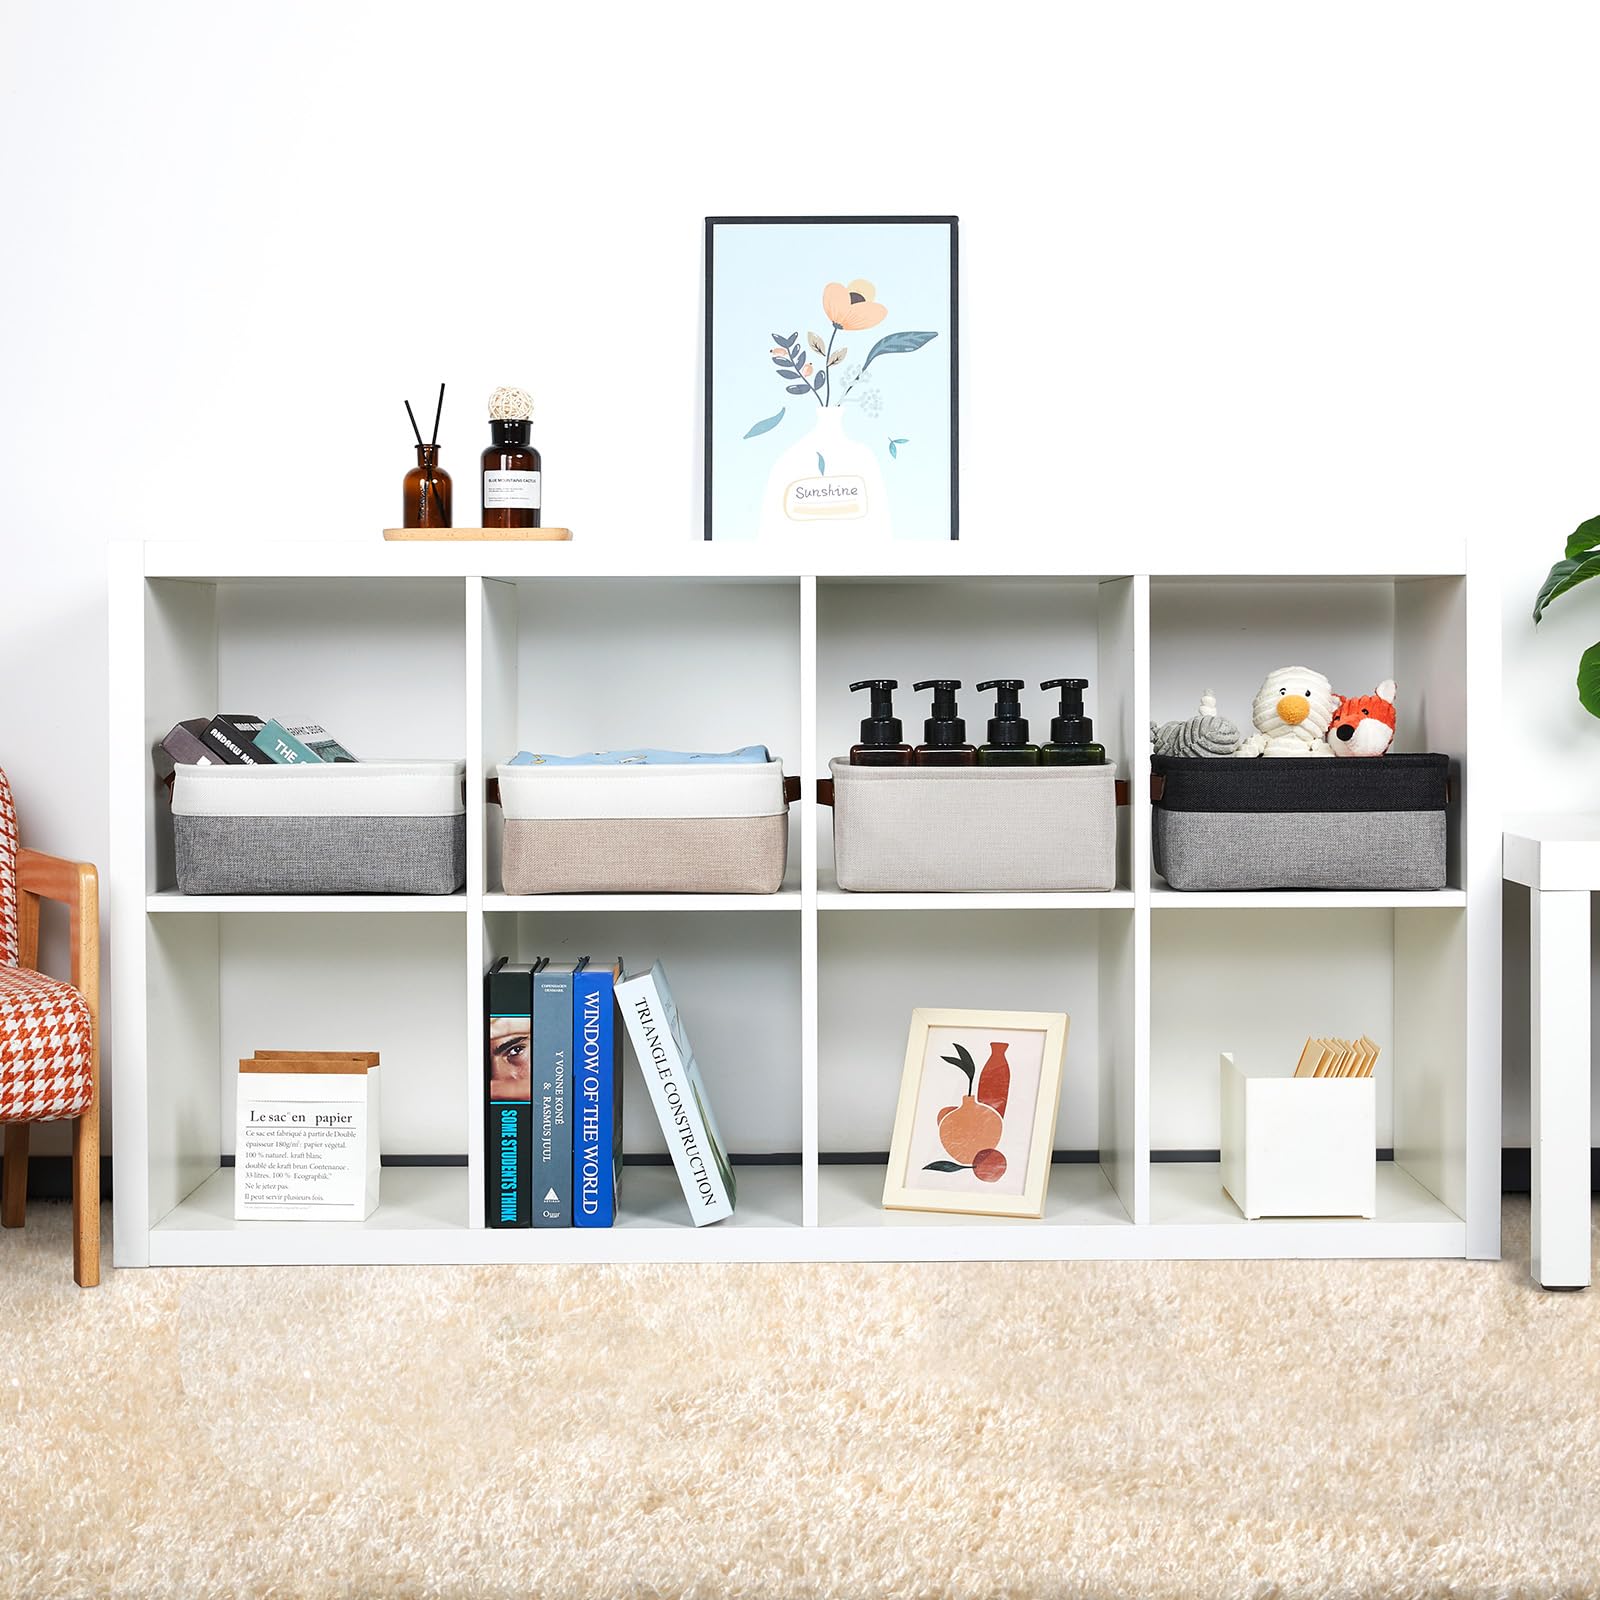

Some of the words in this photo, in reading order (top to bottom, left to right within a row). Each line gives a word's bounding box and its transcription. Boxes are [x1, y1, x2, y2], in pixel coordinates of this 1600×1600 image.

[796, 484, 858, 499] Sunshine
[210, 728, 242, 756] ANDREW
[240, 753, 258, 765] MA
[275, 739, 298, 764] THE
[584, 990, 600, 1074] WINDOW
[583, 1076, 600, 1102] OF
[635, 997, 672, 1080] TRIANGLE
[664, 1082, 716, 1206] CONSTRUCTION
[250, 1110, 266, 1122] Le
[292, 1114, 306, 1122] en
[316, 1112, 352, 1126] papier
[501, 1110, 518, 1138] SOME
[543, 1096, 552, 1136] RASMUS
[583, 1104, 599, 1142] THE
[501, 1140, 518, 1190] STUDENTS
[542, 1138, 552, 1162] JUUL
[582, 1144, 598, 1215] WORLD
[501, 1191, 517, 1222] THINK
